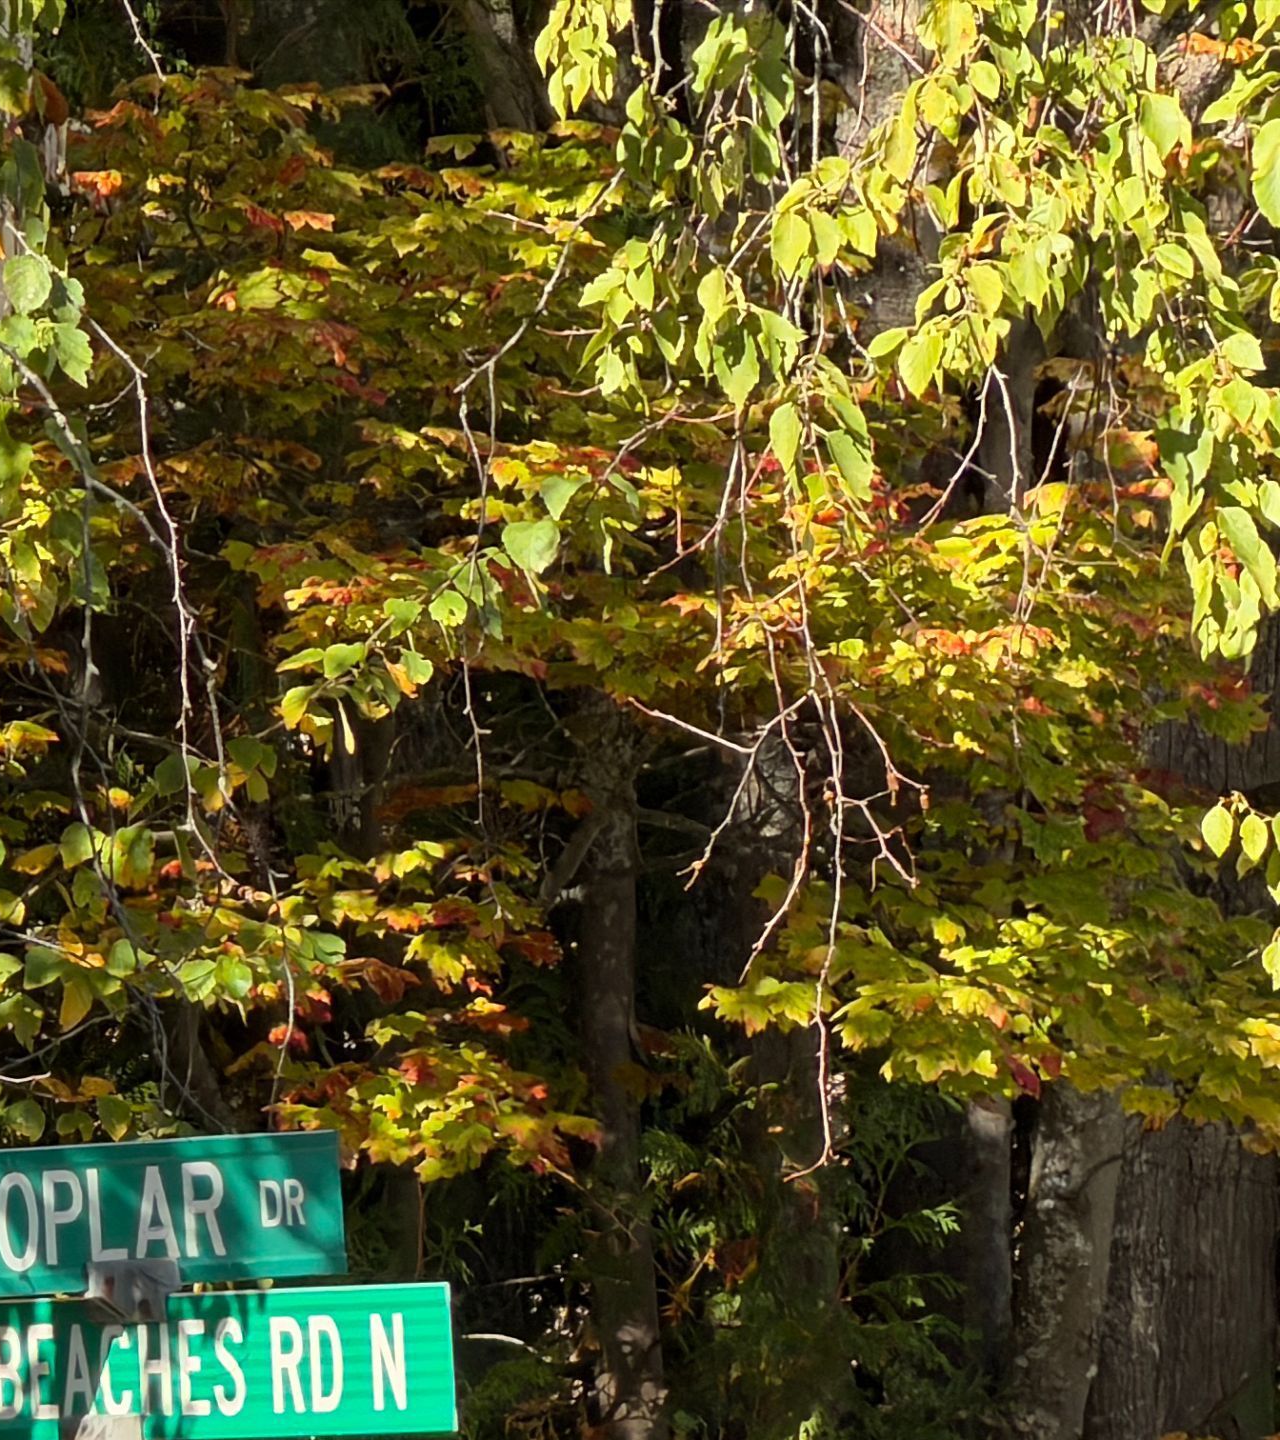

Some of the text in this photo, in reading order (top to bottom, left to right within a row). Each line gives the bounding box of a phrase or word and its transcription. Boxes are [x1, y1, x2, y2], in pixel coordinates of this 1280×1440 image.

[258, 1178, 306, 1228] DR
[269, 1314, 344, 1414] RD
[369, 1311, 408, 1412] N
